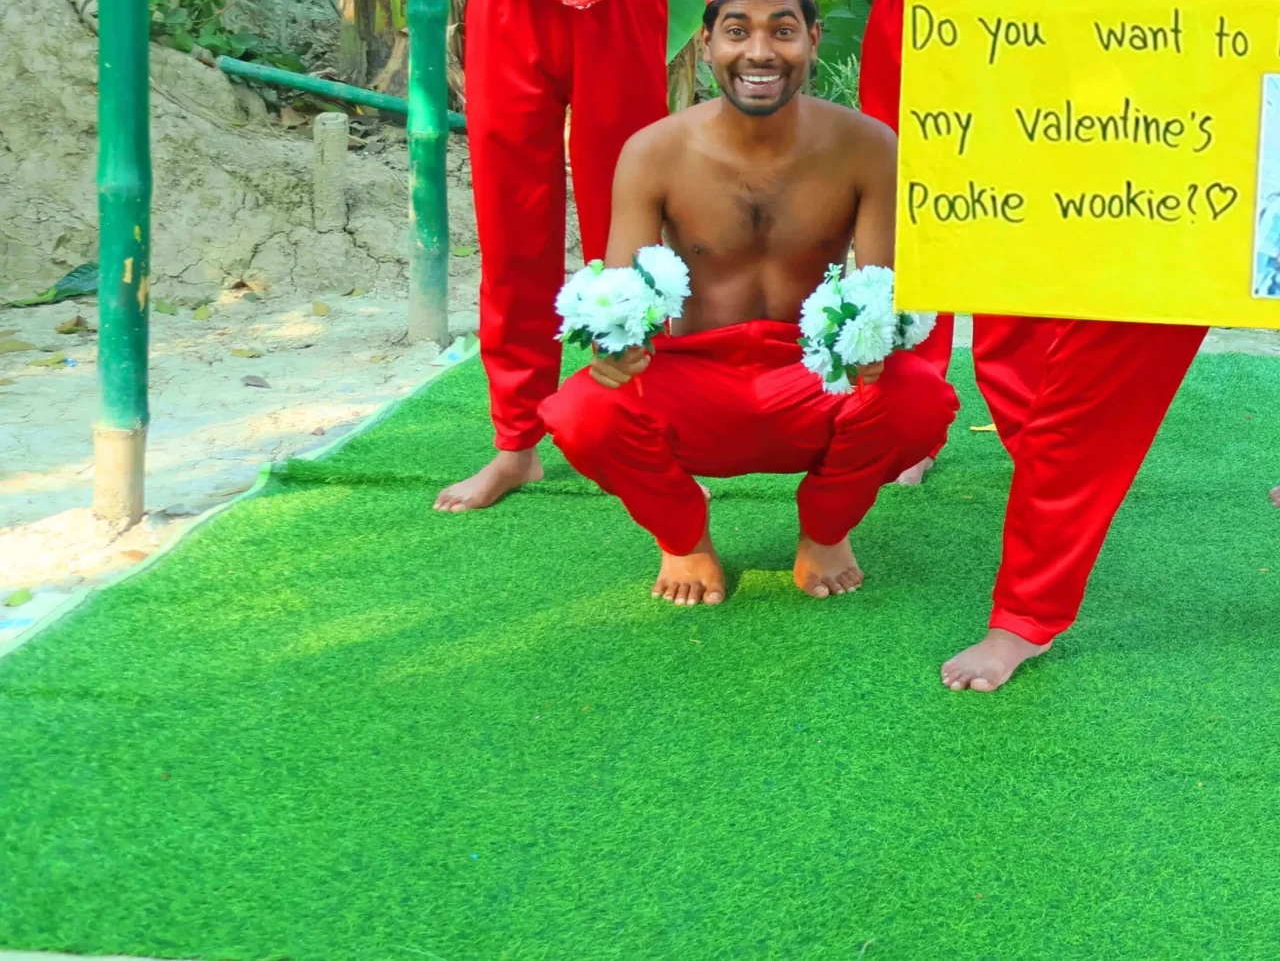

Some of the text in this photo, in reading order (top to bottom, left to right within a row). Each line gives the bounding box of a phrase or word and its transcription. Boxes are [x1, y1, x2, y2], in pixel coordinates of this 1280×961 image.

[911, 4, 958, 50] Do
[977, 16, 1046, 65] you
[1094, 8, 1183, 54] want
[1214, 16, 1250, 58] to
[910, 110, 973, 155] my
[908, 181, 1025, 224] Pookie
